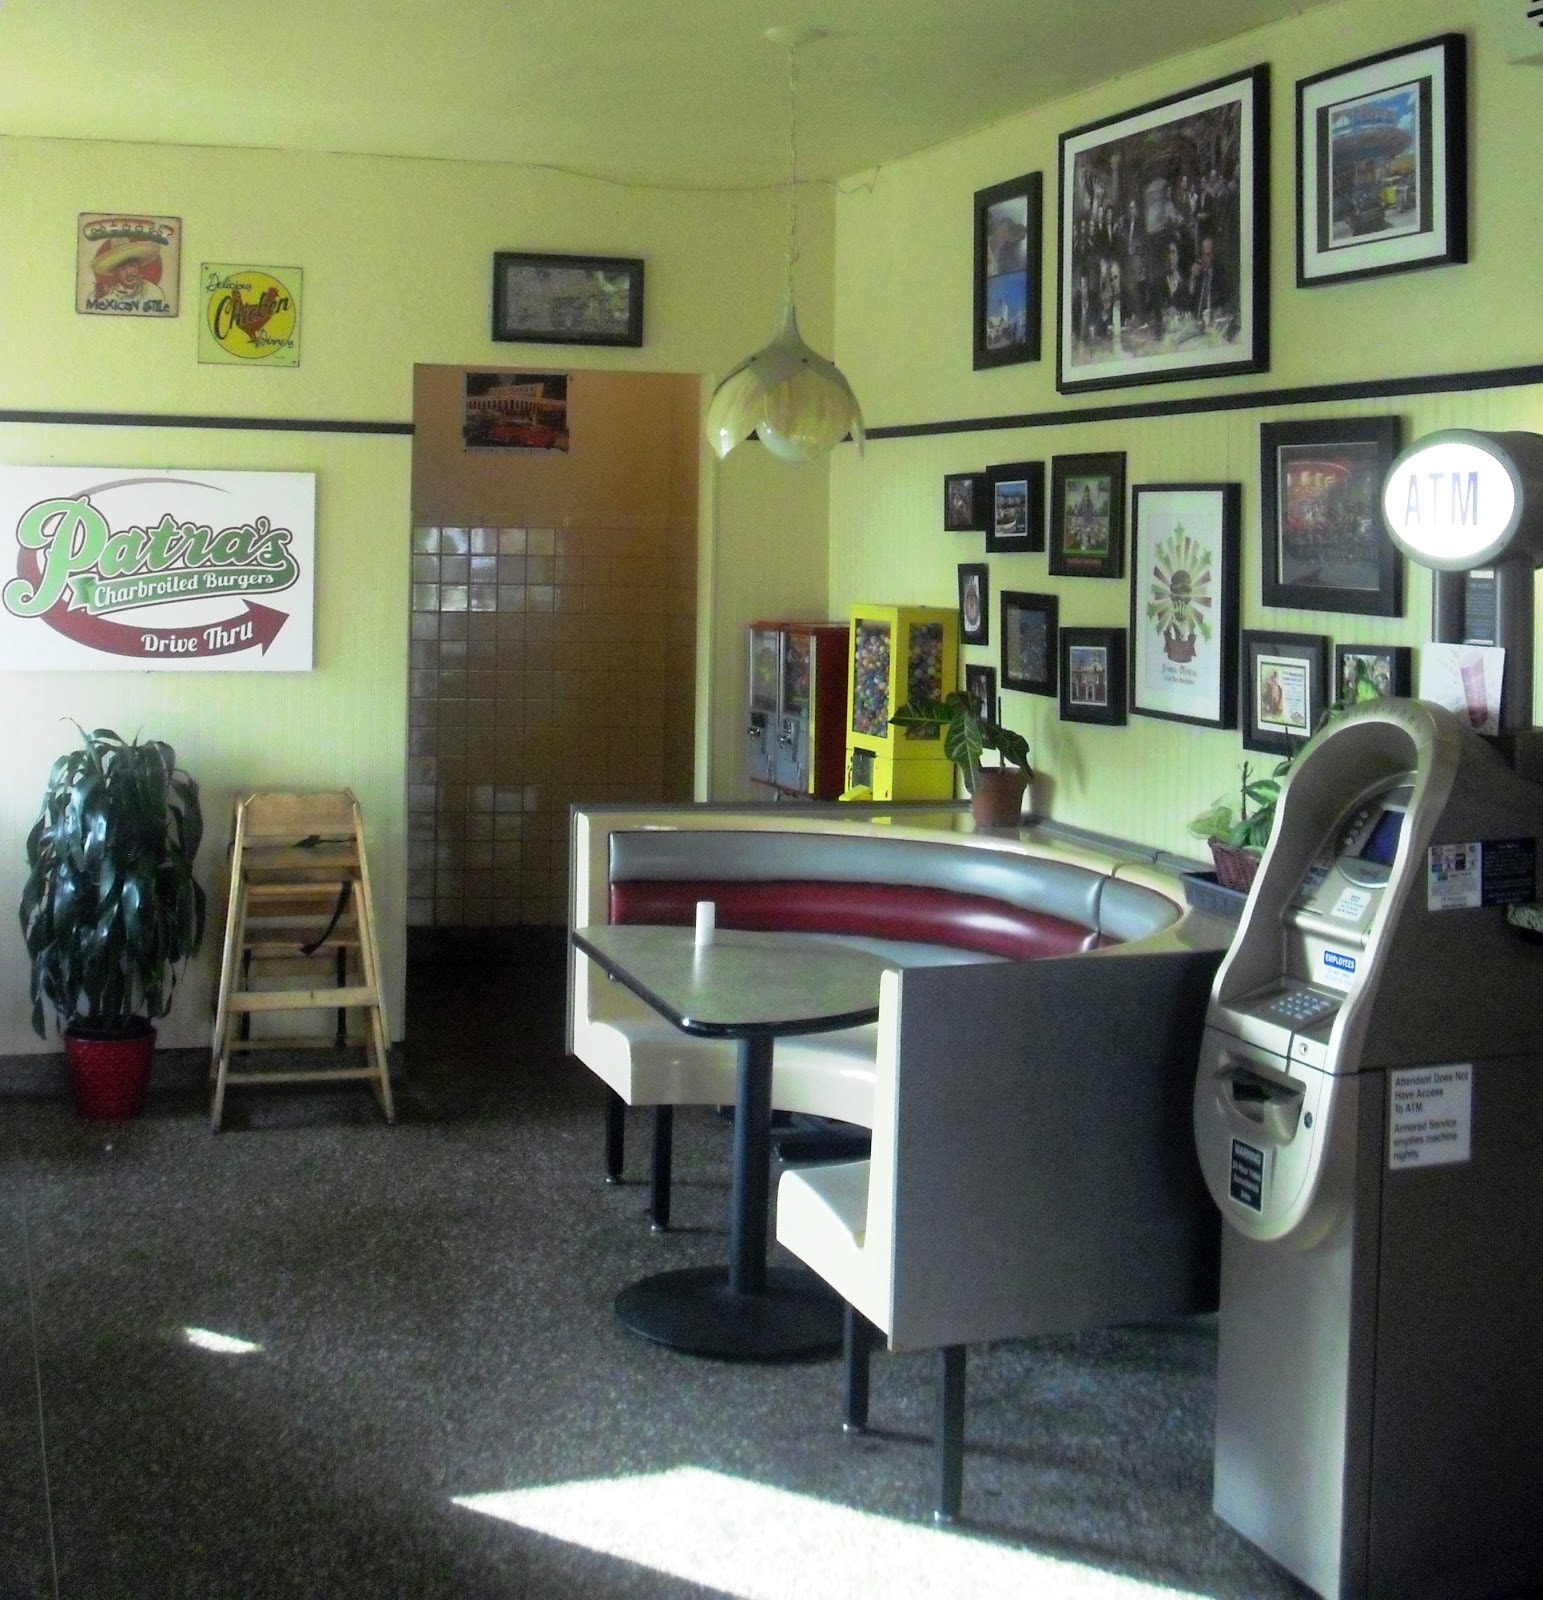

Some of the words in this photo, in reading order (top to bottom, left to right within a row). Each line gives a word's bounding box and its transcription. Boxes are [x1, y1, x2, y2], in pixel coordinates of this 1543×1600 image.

[1404, 470, 1478, 527] ATM
[3, 495, 293, 617] Patra's
[94, 573, 199, 608] Charbroiled
[203, 572, 274, 589] Burgers
[140, 633, 198, 653] Drive
[203, 621, 253, 650] Thru
